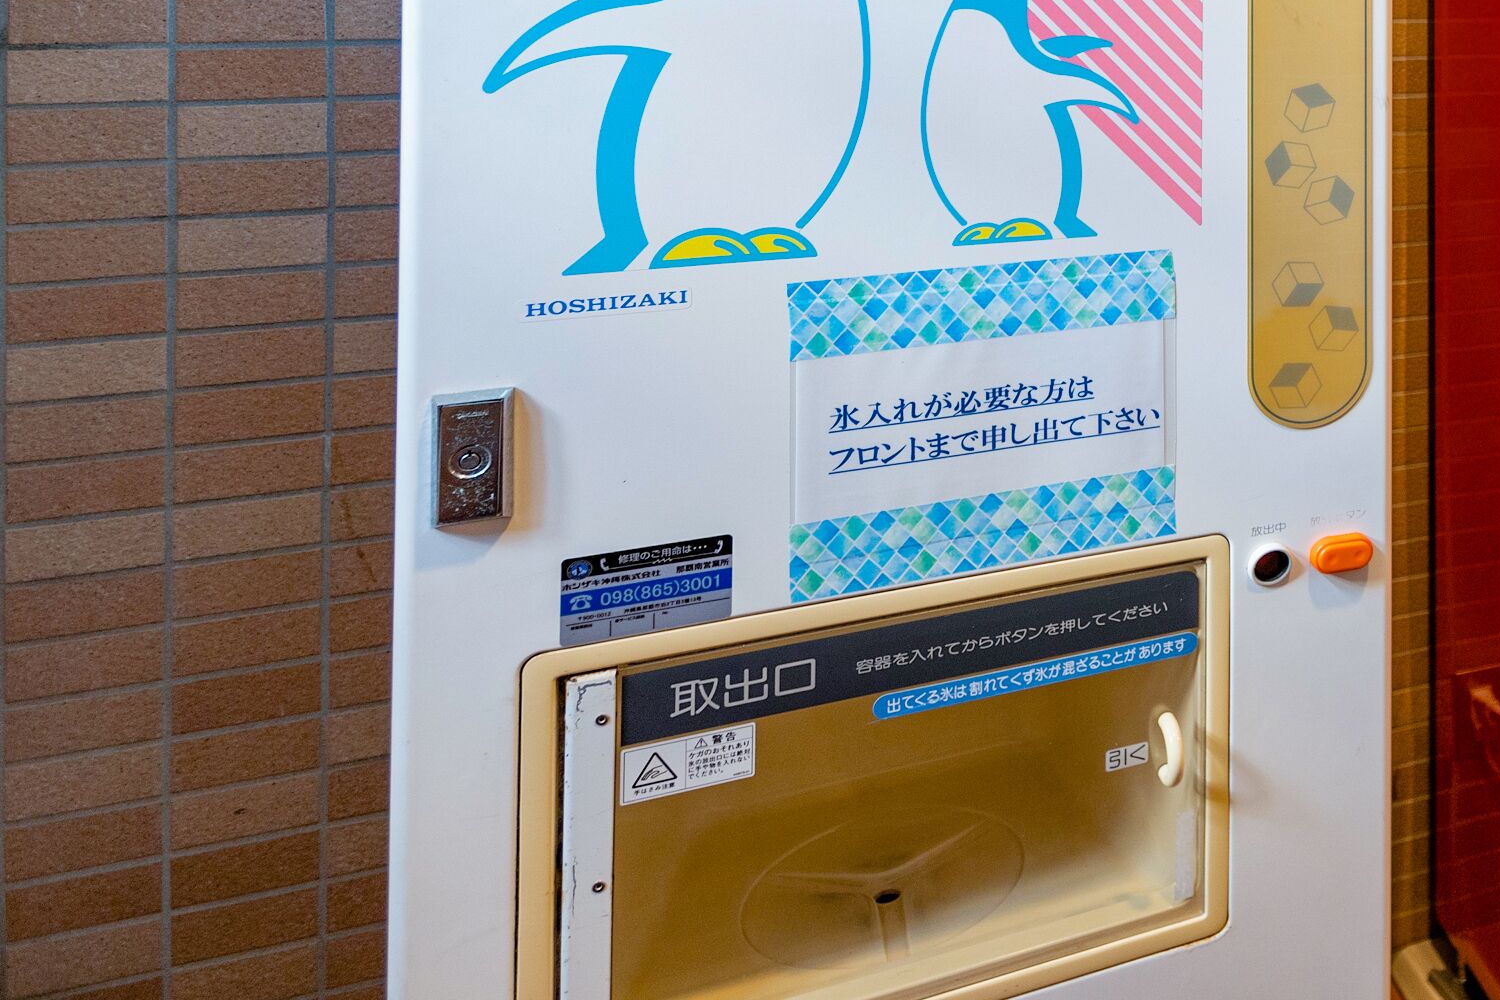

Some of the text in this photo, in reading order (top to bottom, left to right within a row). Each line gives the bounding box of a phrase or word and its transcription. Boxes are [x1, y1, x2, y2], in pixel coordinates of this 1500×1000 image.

[525, 289, 688, 317] HOSHIZAKI
[830, 375, 1095, 430] 氷入れが必要な方は
[829, 407, 1160, 472] フロントまで申し出て下さい
[1251, 521, 1288, 537] 放出中
[600, 574, 721, 606] 098(865)3001
[670, 601, 1169, 718] 取出口 容器を入れてからボタンを押してください
[689, 740, 750, 760] ケガのおそれあり
[712, 731, 736, 745] 警告
[1109, 743, 1147, 770] 引く
